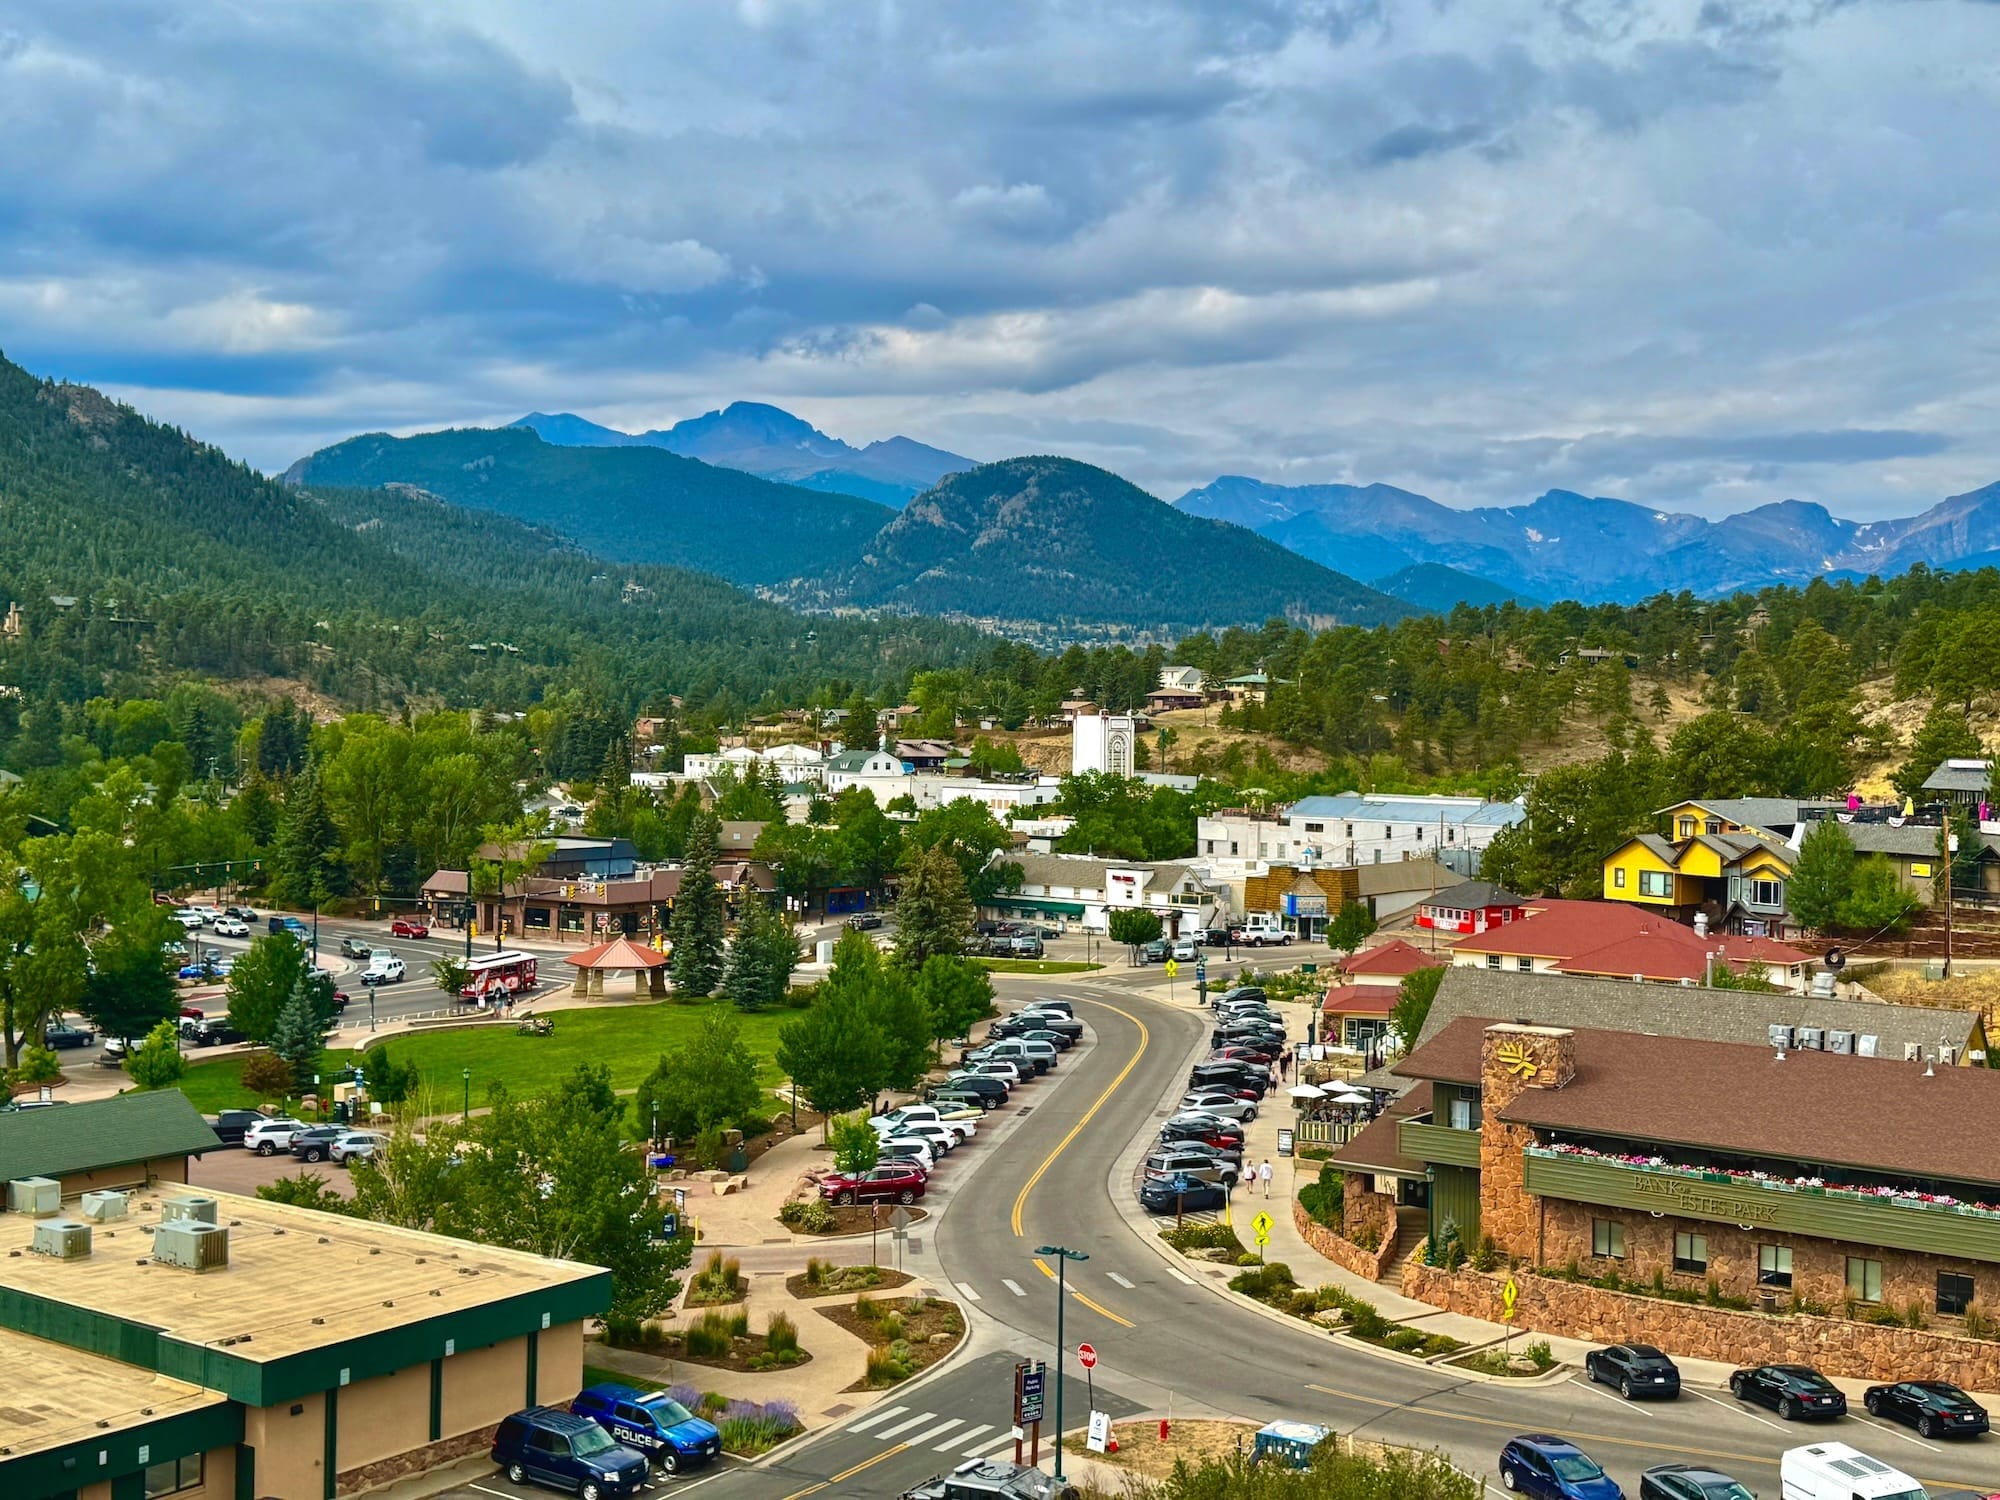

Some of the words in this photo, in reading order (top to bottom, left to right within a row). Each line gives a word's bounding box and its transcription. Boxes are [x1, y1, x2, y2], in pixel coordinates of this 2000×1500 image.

[1633, 1175, 1680, 1195] BANK
[1679, 1194, 1729, 1215] ESTES
[1733, 1201, 1779, 1222] PARK
[1079, 1350, 1095, 1361] STOP
[614, 1427, 653, 1447] POLICE
